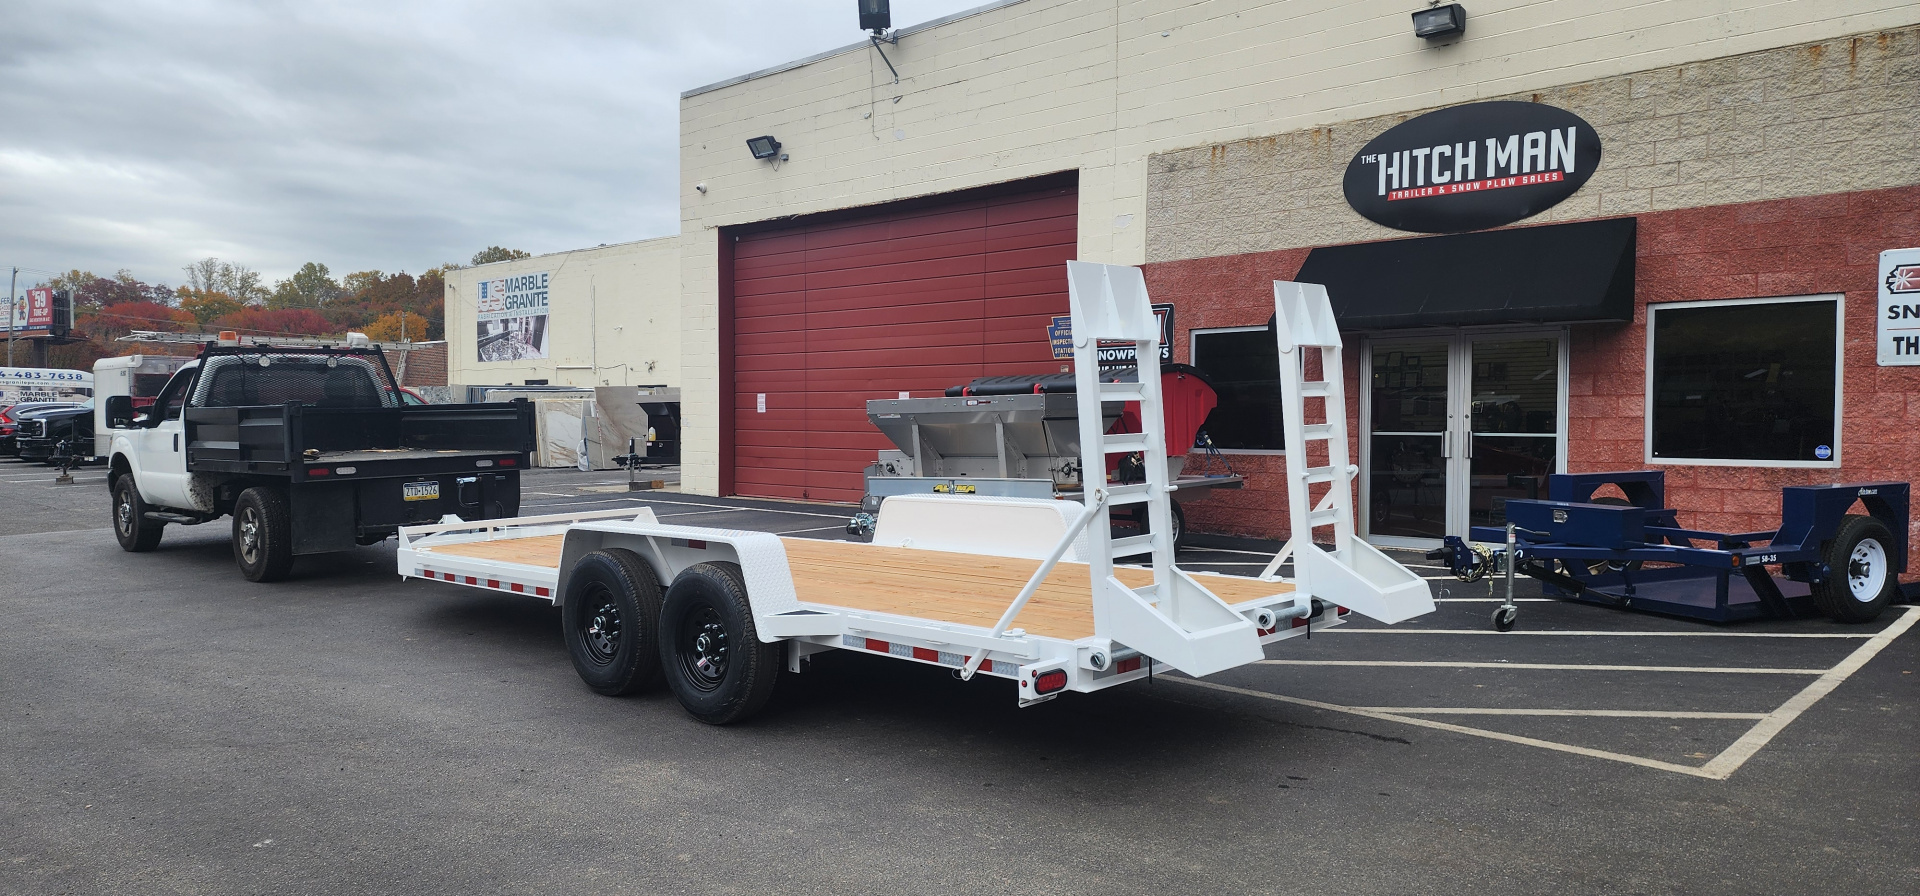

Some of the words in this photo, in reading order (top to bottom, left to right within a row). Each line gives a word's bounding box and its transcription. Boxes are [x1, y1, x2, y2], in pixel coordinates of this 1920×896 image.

[1361, 154, 1377, 165] THE
[1377, 140, 1477, 196] HITCH
[1485, 126, 1577, 178] MAN
[1392, 188, 1433, 199] TRAILER
[1438, 186, 1445, 194] &
[1452, 182, 1481, 193] SNOW
[1487, 178, 1516, 188] PLOW
[1522, 173, 1558, 184] SALES
[505, 273, 548, 293] MARBLE
[505, 291, 548, 310] GRANITE
[478, 311, 507, 320] FABRICATION
[513, 307, 549, 318] INSTALLATION
